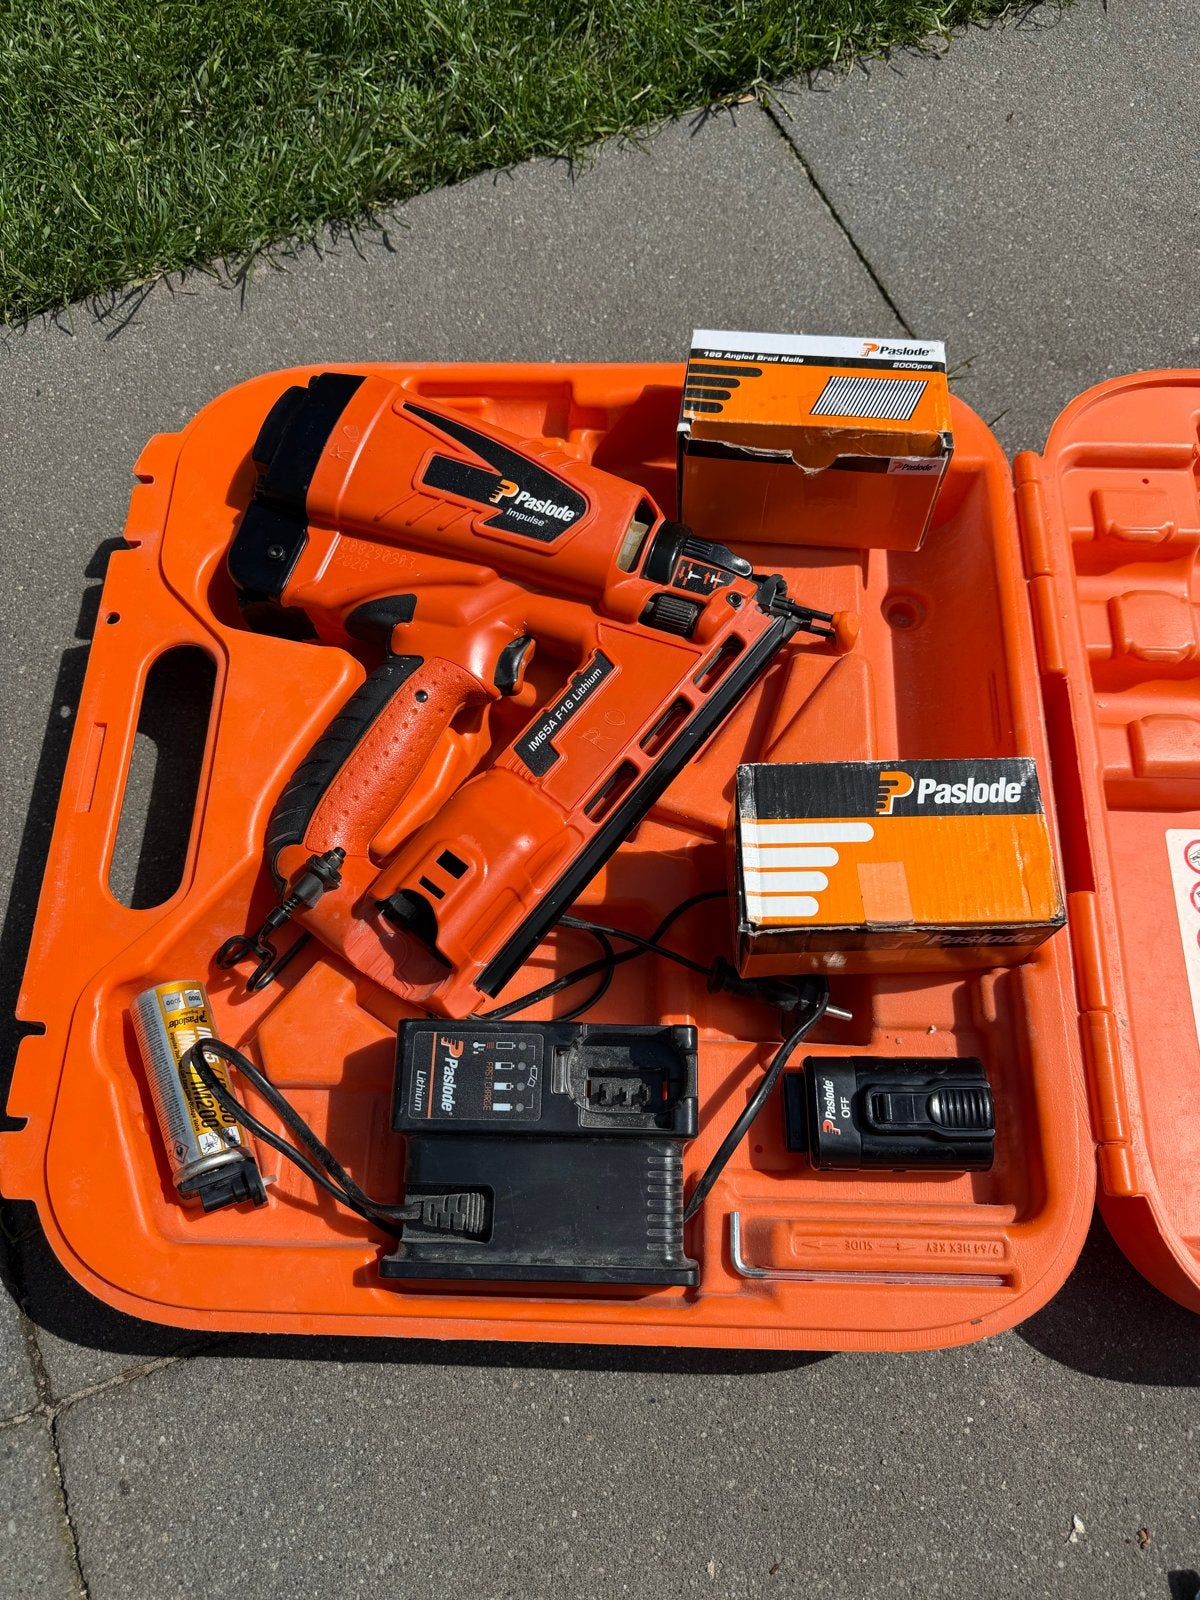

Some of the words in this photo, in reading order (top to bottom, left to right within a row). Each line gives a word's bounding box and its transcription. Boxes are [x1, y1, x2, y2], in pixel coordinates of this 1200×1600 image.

[724, 352, 755, 361] Angled
[879, 346, 930, 357] Paslode
[901, 463, 933, 472] Paslode
[514, 490, 576, 523] Paslode
[506, 507, 546, 527] Impulse
[528, 719, 558, 752] IM65A
[555, 699, 574, 721] F16
[572, 668, 603, 701] Lithium
[917, 777, 1022, 804] Paslode
[926, 933, 1035, 946] Paslode
[414, 1070, 426, 1111] Lithium
[441, 1057, 459, 1112] Paslode
[825, 1079, 837, 1120] Paslode
[840, 1096, 850, 1118] OFF
[844, 1239, 873, 1251] SLIDE
[926, 1241, 946, 1253] KEY
[949, 1242, 972, 1254] HEX
